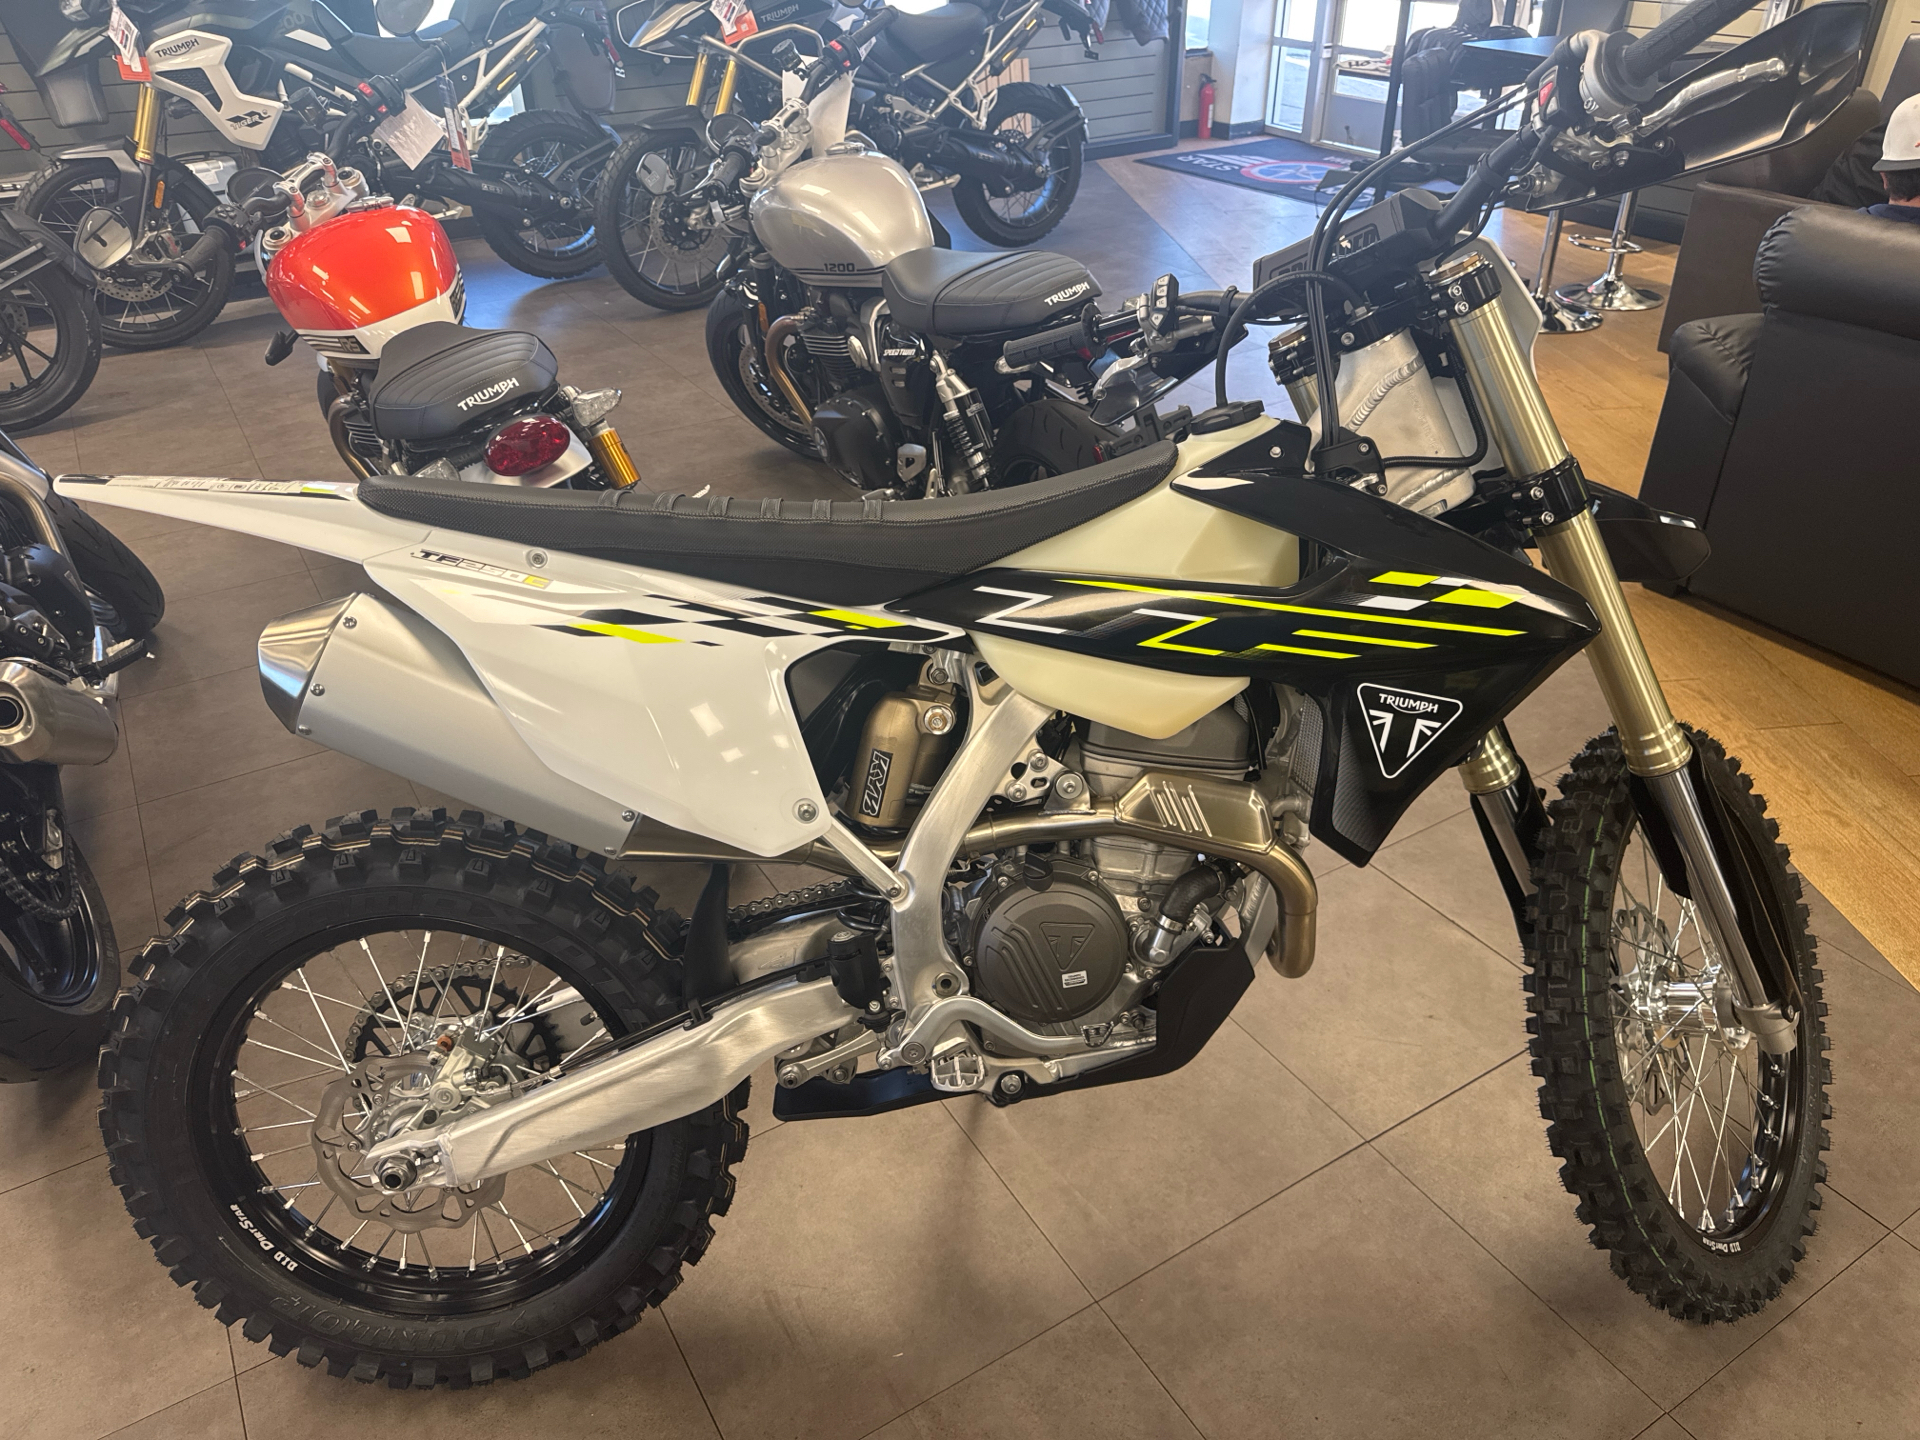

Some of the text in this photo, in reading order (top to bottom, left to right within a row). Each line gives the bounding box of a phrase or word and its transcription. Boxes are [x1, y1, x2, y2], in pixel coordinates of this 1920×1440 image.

[760, 3, 797, 23] TRIUMPH
[154, 38, 200, 58] TRIUMPH
[230, 114, 260, 130] TIGER
[1176, 154, 1240, 172] STAR
[823, 262, 856, 273] 1200
[1043, 281, 1091, 307] TRIUMPH
[339, 337, 361, 352] RS
[457, 377, 520, 411] TRIUMPH
[1378, 692, 1439, 714] TRIUMPH
